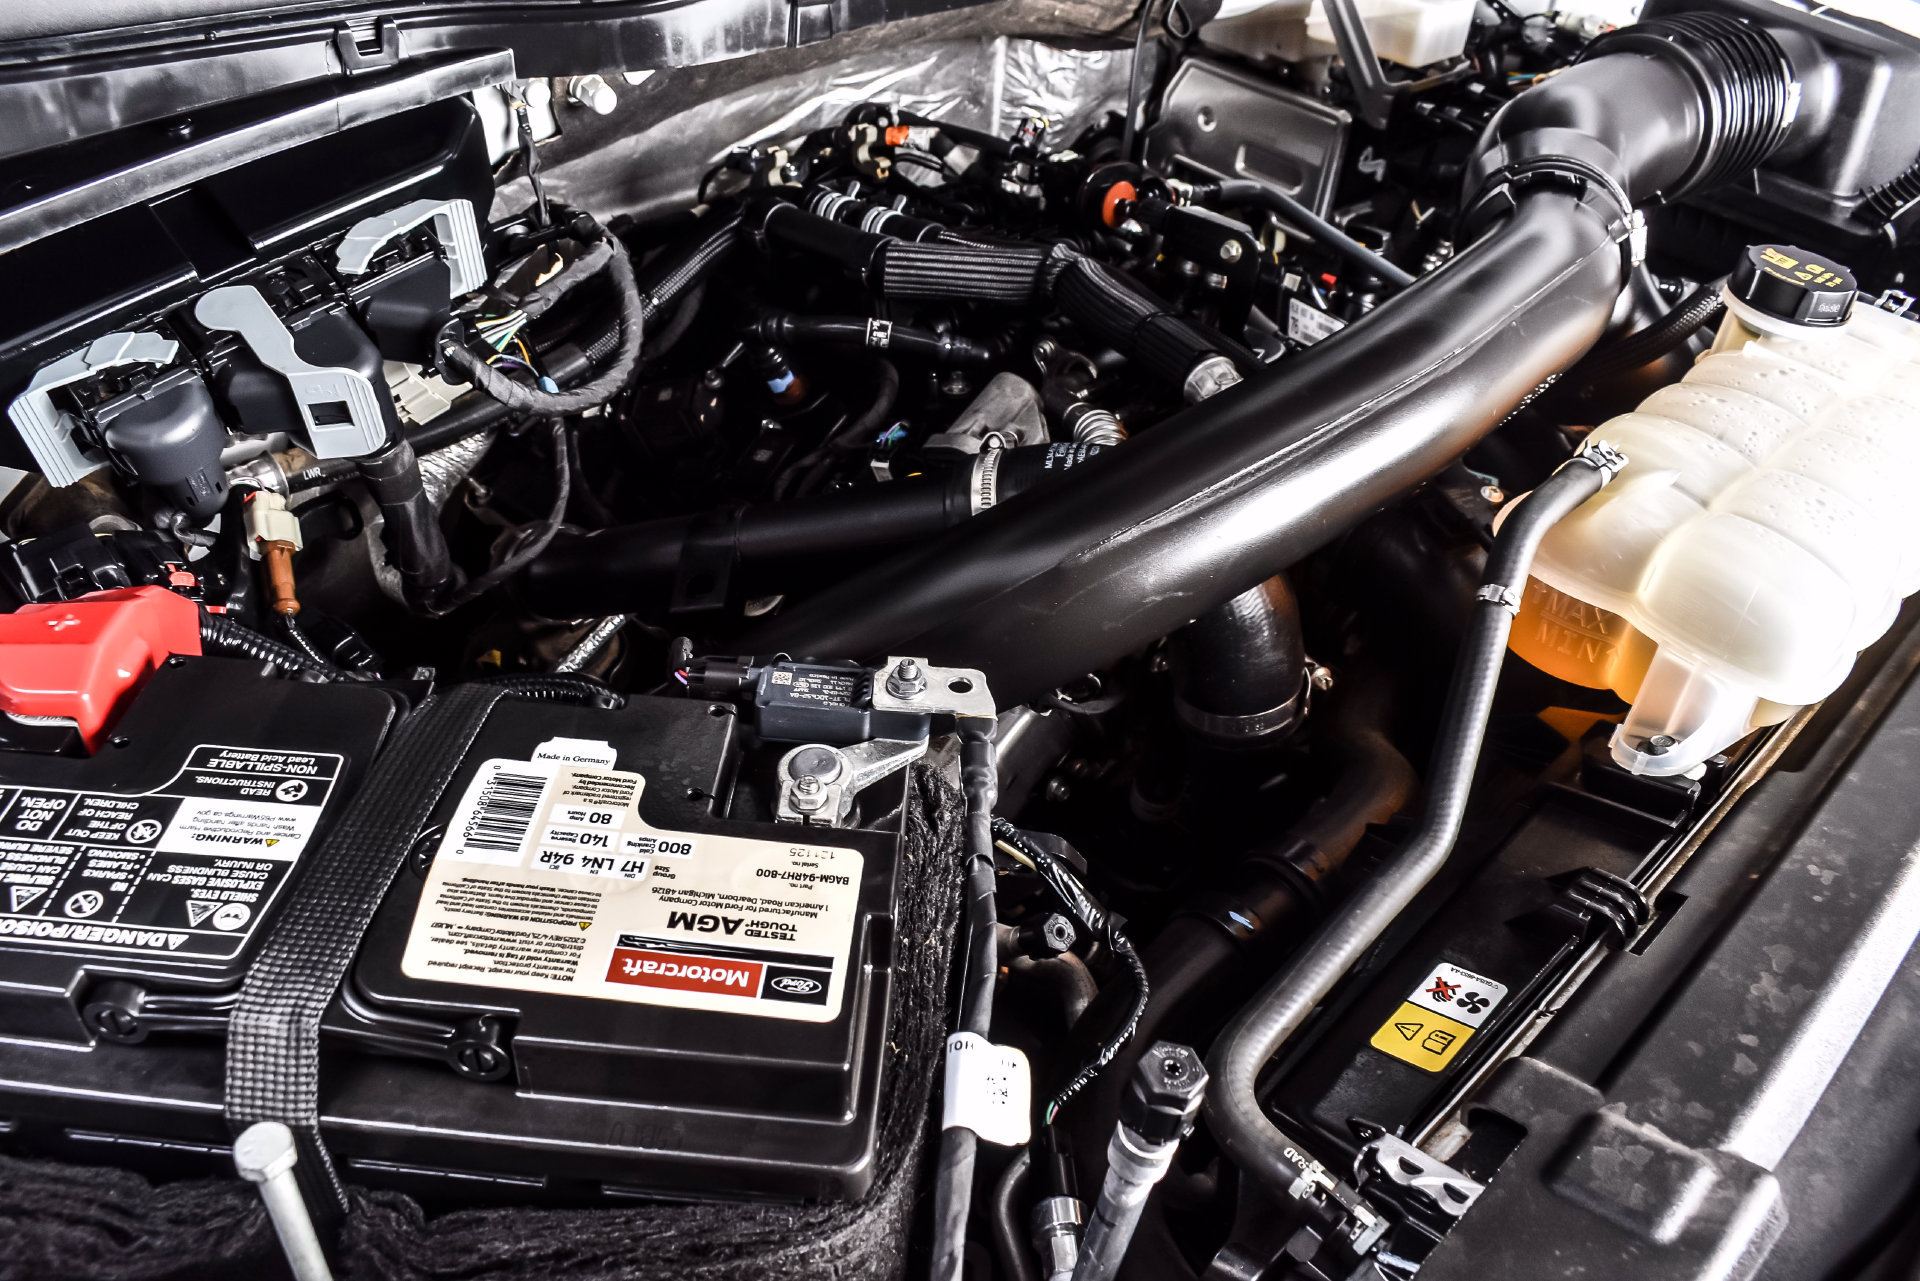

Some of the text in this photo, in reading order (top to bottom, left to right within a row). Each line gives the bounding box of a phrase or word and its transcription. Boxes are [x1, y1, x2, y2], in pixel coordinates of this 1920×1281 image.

[302, 467, 322, 481] LWR
[1546, 593, 1612, 634] MAX
[1535, 620, 1602, 663] MIN
[219, 749, 315, 765] Lead Acid Battery
[537, 752, 610, 766] Made in Germany
[206, 758, 318, 774] NON-SPILLABLE
[195, 775, 276, 788] INSTRUCTIONS.
[586, 780, 635, 790] Recommended
[239, 787, 271, 796] READ
[476, 779, 496, 805] 31508
[570, 790, 601, 798] trademark
[20, 796, 66, 810] OPEN.
[83, 797, 139, 810] CHILDREN.
[17, 808, 55, 821] NOT
[77, 808, 133, 820] REACH OF
[588, 812, 612, 824] 80
[15, 819, 43, 831] DO
[87, 819, 127, 830] OF THE
[192, 816, 225, 825] handling
[247, 821, 270, 829] hands
[462, 810, 481, 837] 64566
[63, 828, 121, 840] KEEP OUT
[203, 826, 253, 835] Reproductive
[549, 829, 578, 838] Capacity
[191, 833, 263, 845] WARNING:
[550, 835, 576, 843] Reserve
[579, 833, 608, 847] 140
[626, 840, 656, 849] Cranking
[28, 843, 75, 855] SEVERE
[86, 848, 140, 860] SMOKING
[658, 841, 692, 855] 800
[5, 852, 68, 864] BLINDNESS
[87, 858, 134, 870] FLAMES
[539, 850, 644, 873] H7 LN4 94R
[35, 864, 62, 874] CAN
[213, 858, 273, 871] OR INJURY.
[81, 868, 128, 880] SPARKS
[166, 864, 268, 880] CAUSE BLINDNESS
[652, 870, 676, 879] Group
[755, 868, 849, 885] BAGM-94RH7-800
[109, 881, 129, 892] NO
[146, 872, 264, 890] EXPLOSIVE GASES CAN
[190, 888, 259, 903] SHIELD EYES.
[651, 886, 677, 895] 48126
[677, 889, 715, 900] Michigan
[658, 894, 698, 906] Company
[698, 900, 724, 909] Motor
[717, 893, 757, 904] Dearborn,
[759, 898, 783, 907] Road,
[724, 902, 744, 911] Ford
[784, 901, 824, 911] American
[758, 906, 818, 919] Manufactured
[666, 911, 744, 935] AGM
[0, 918, 169, 947] DANGER/POISO
[744, 928, 795, 941] TESTED
[498, 944, 532, 952] warranty
[532, 948, 568, 956] complete
[544, 942, 584, 951] distributor
[427, 960, 458, 968] required
[532, 963, 564, 971] warranty
[542, 956, 578, 966] Warranty
[458, 963, 485, 972] Receipt
[622, 958, 749, 987] Motorcraft
[549, 973, 574, 982] NOTE:
[1284, 1147, 1307, 1169] RAD
